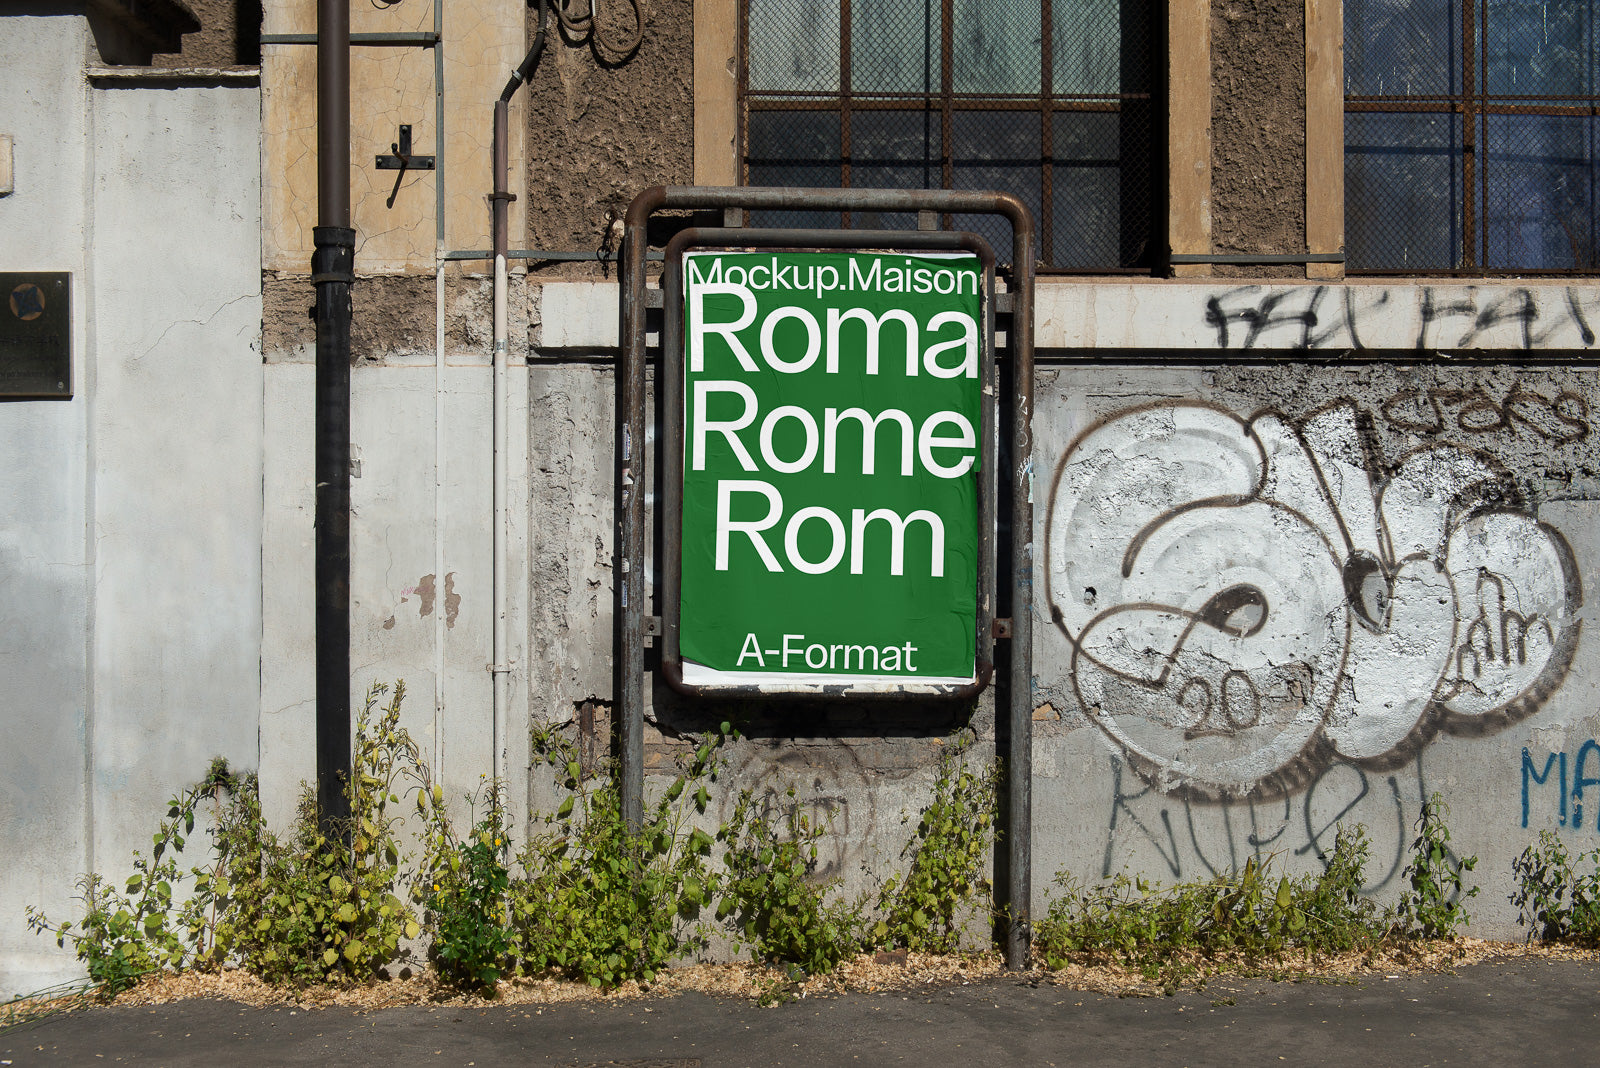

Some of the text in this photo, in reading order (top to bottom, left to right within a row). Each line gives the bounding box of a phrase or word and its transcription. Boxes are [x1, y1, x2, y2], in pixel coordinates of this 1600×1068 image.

[687, 256, 978, 299] Mockup.Maison
[688, 281, 979, 379] Roma
[692, 380, 977, 479] Rome
[715, 479, 945, 578] Rom
[736, 633, 918, 672] A-Format
